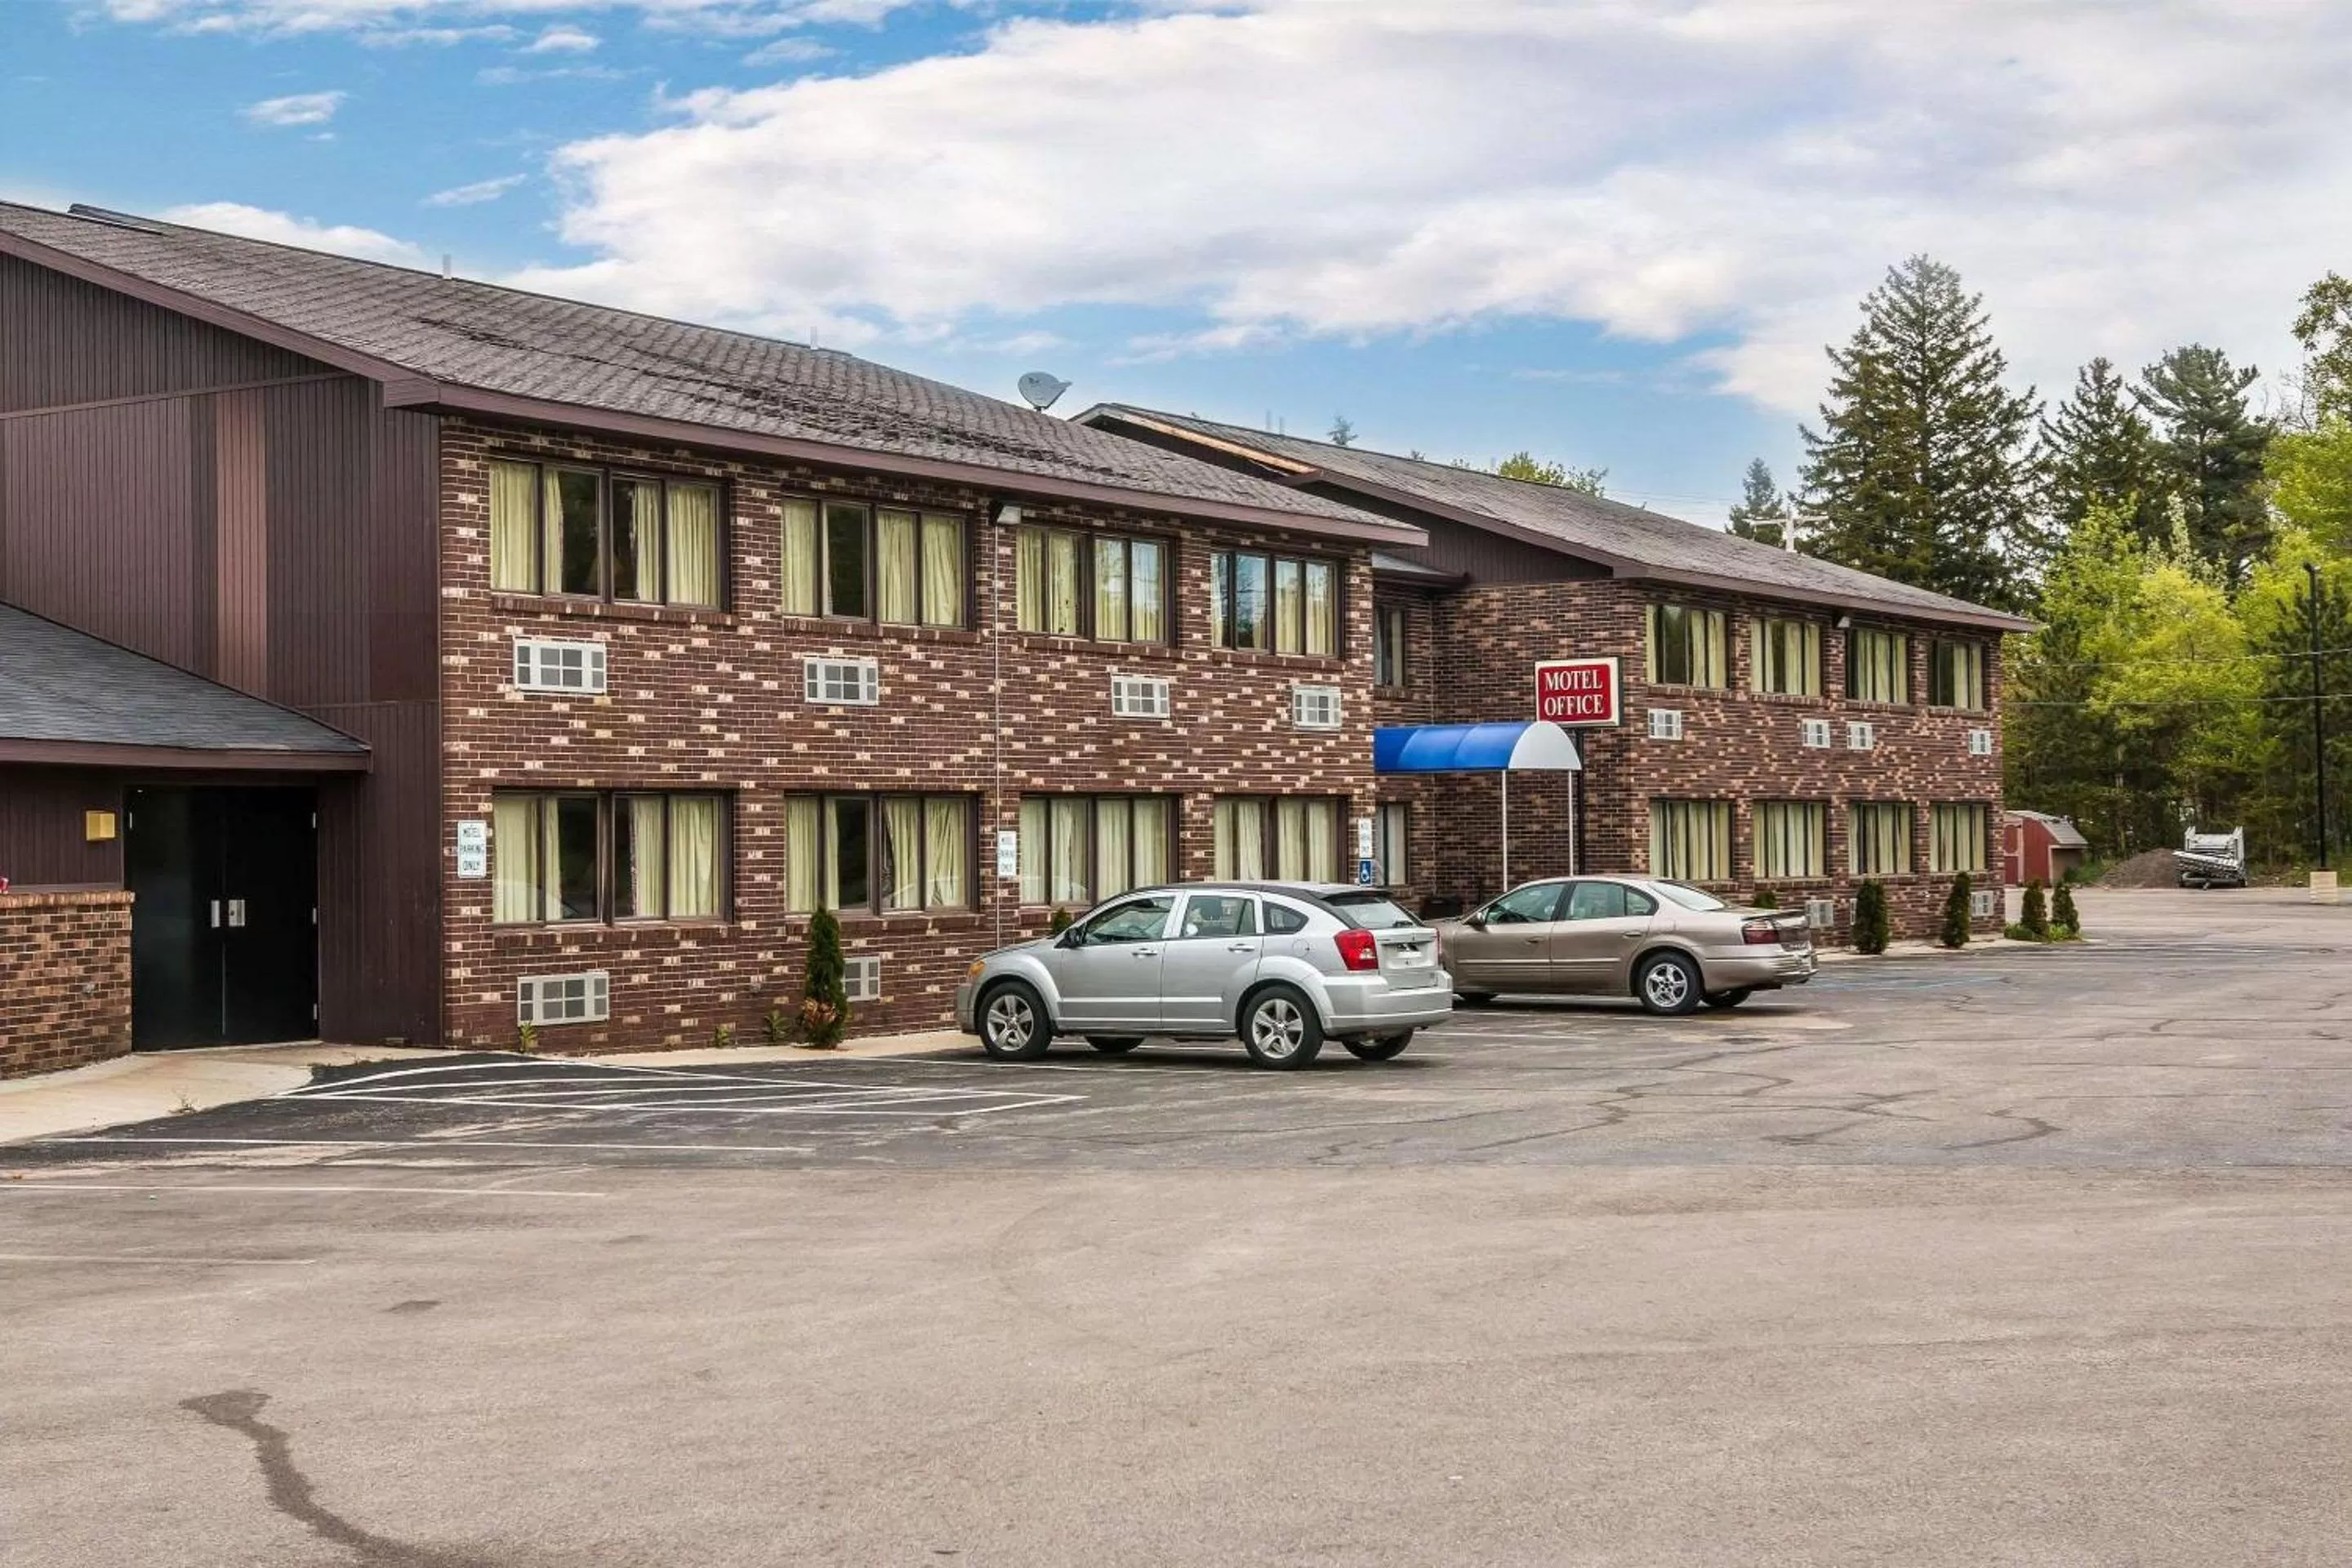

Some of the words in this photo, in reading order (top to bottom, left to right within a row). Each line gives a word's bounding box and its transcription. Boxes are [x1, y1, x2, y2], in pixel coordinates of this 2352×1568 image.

[1544, 670, 1603, 691] MOTEL
[1544, 694, 1604, 716] OFFICE
[463, 860, 480, 871] ONLY
